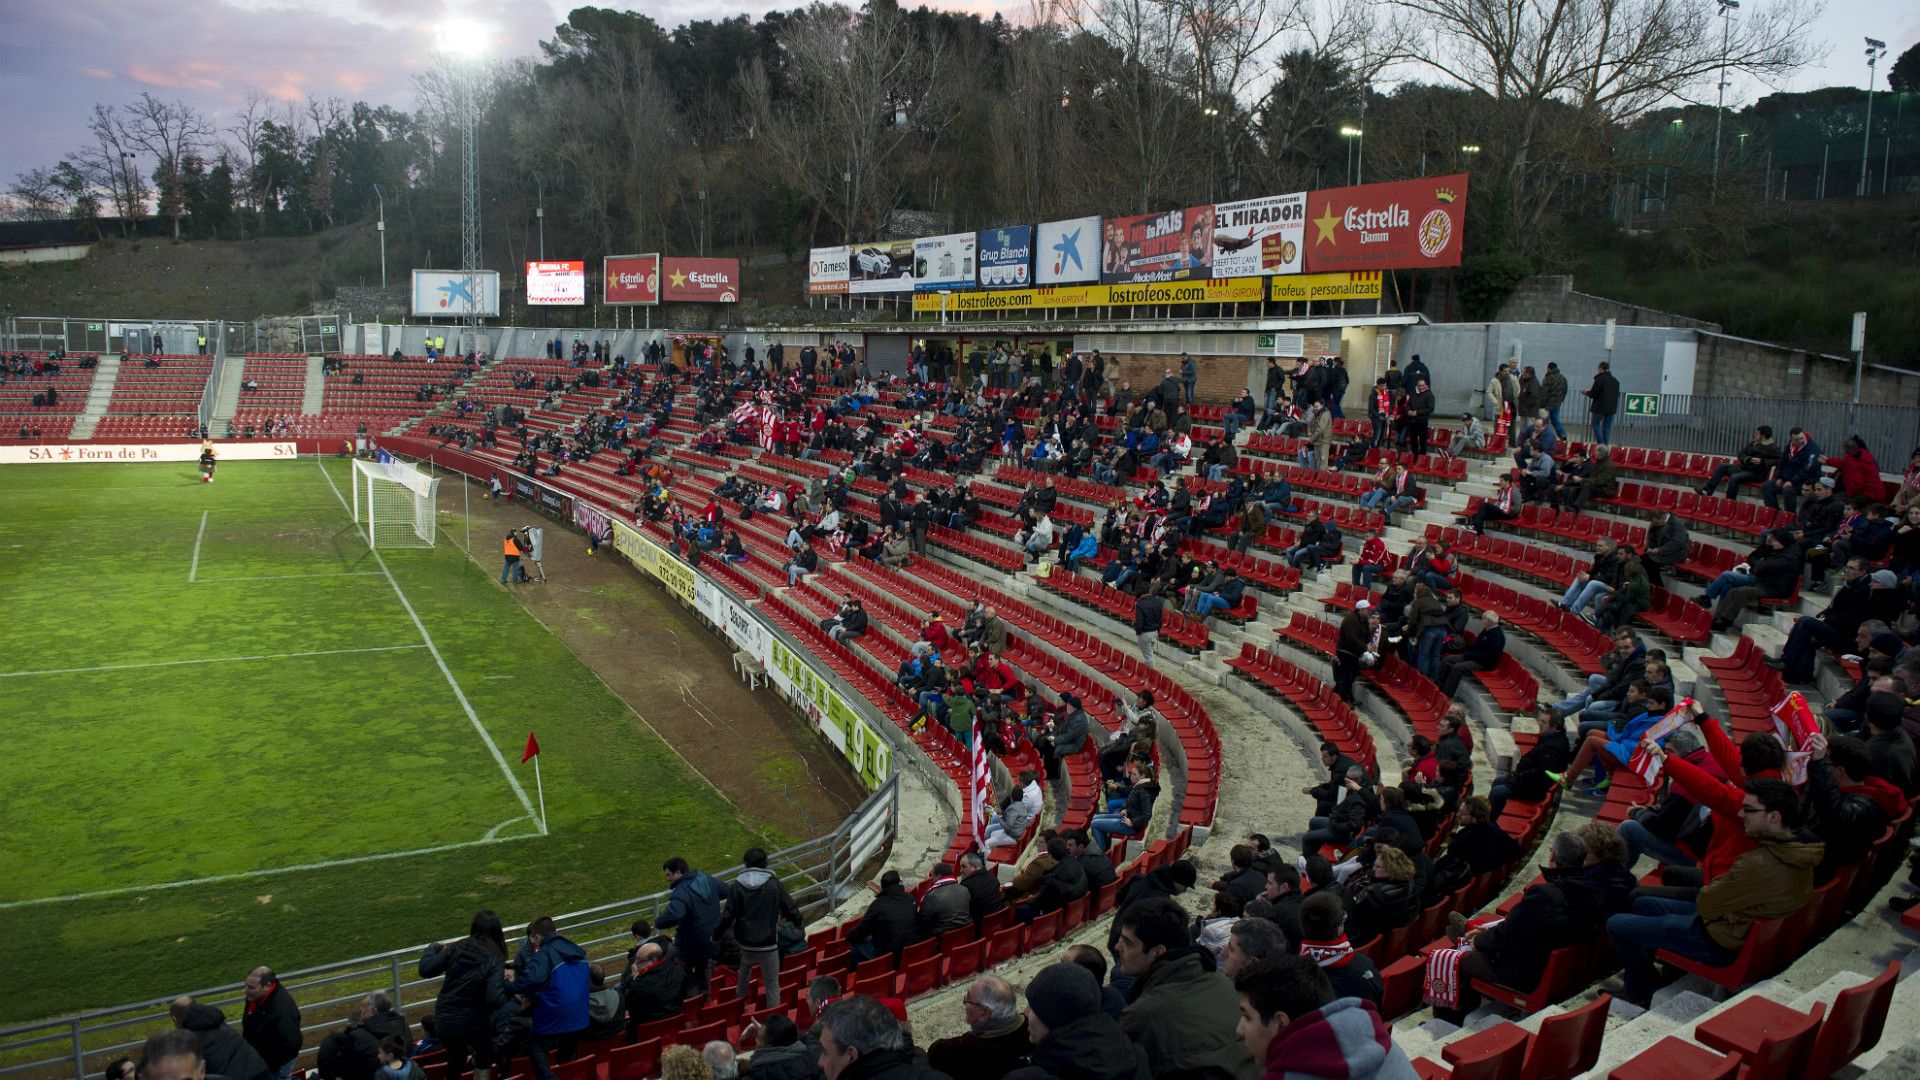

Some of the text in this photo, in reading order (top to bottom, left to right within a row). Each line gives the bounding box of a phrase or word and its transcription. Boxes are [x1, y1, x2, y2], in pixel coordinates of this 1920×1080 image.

[1250, 200, 1263, 208] PARC
[1215, 203, 1303, 228] EL MIRADOR
[1344, 203, 1410, 232] Estrella
[1360, 231, 1389, 244] Damm
[980, 245, 1029, 263] Grup Blanch
[820, 257, 848, 273] Tamesol
[689, 271, 728, 284] Estrella
[1108, 283, 1205, 303] lostrofeos.com
[1273, 281, 1379, 298] Trofeus personalitzats
[957, 292, 1032, 309] lostrofeos.com
[29, 447, 158, 460] SA Forn de Pa
[274, 444, 294, 456] SA
[845, 719, 864, 774] EL 9
[866, 744, 876, 780] EL
